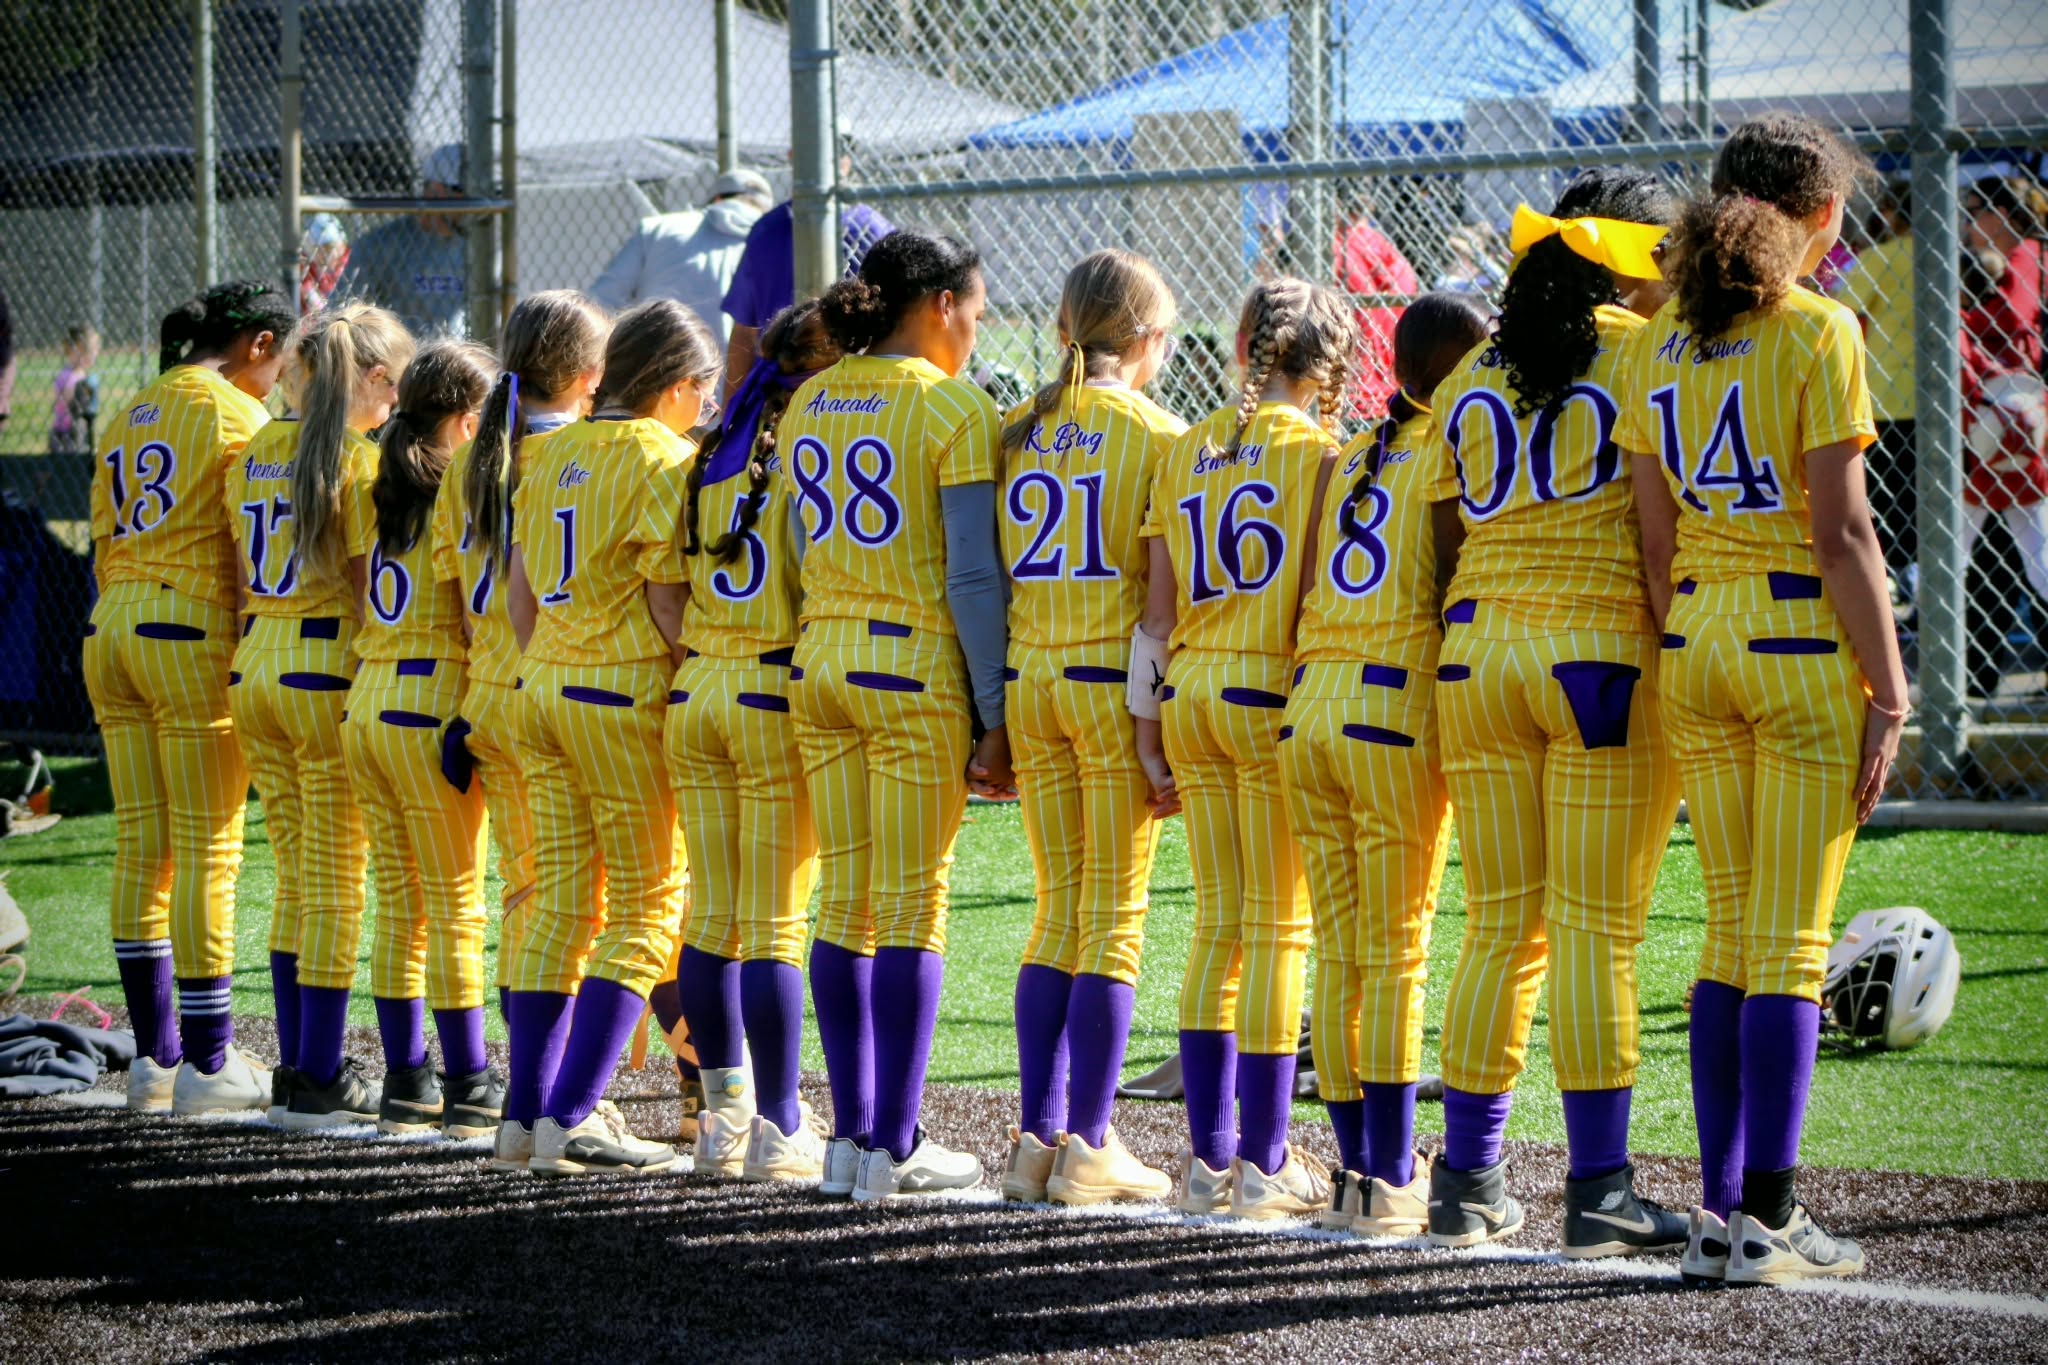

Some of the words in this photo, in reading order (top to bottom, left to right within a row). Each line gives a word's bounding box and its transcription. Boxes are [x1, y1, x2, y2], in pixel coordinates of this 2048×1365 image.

[129, 403, 160, 428] Tink
[803, 389, 889, 415] Avacado
[1025, 424, 1051, 454] K
[1053, 422, 1104, 456] Bug
[1445, 381, 1618, 519] 00
[1647, 381, 1784, 513] 14
[105, 441, 176, 540] 13
[792, 434, 901, 548] 88
[1343, 448, 1412, 475] Gce
[541, 505, 577, 606] 1
[711, 494, 769, 601] 5
[1006, 470, 1120, 582] 21
[1179, 480, 1286, 605] 16
[1329, 485, 1393, 599] 8
[367, 538, 412, 626] 6
